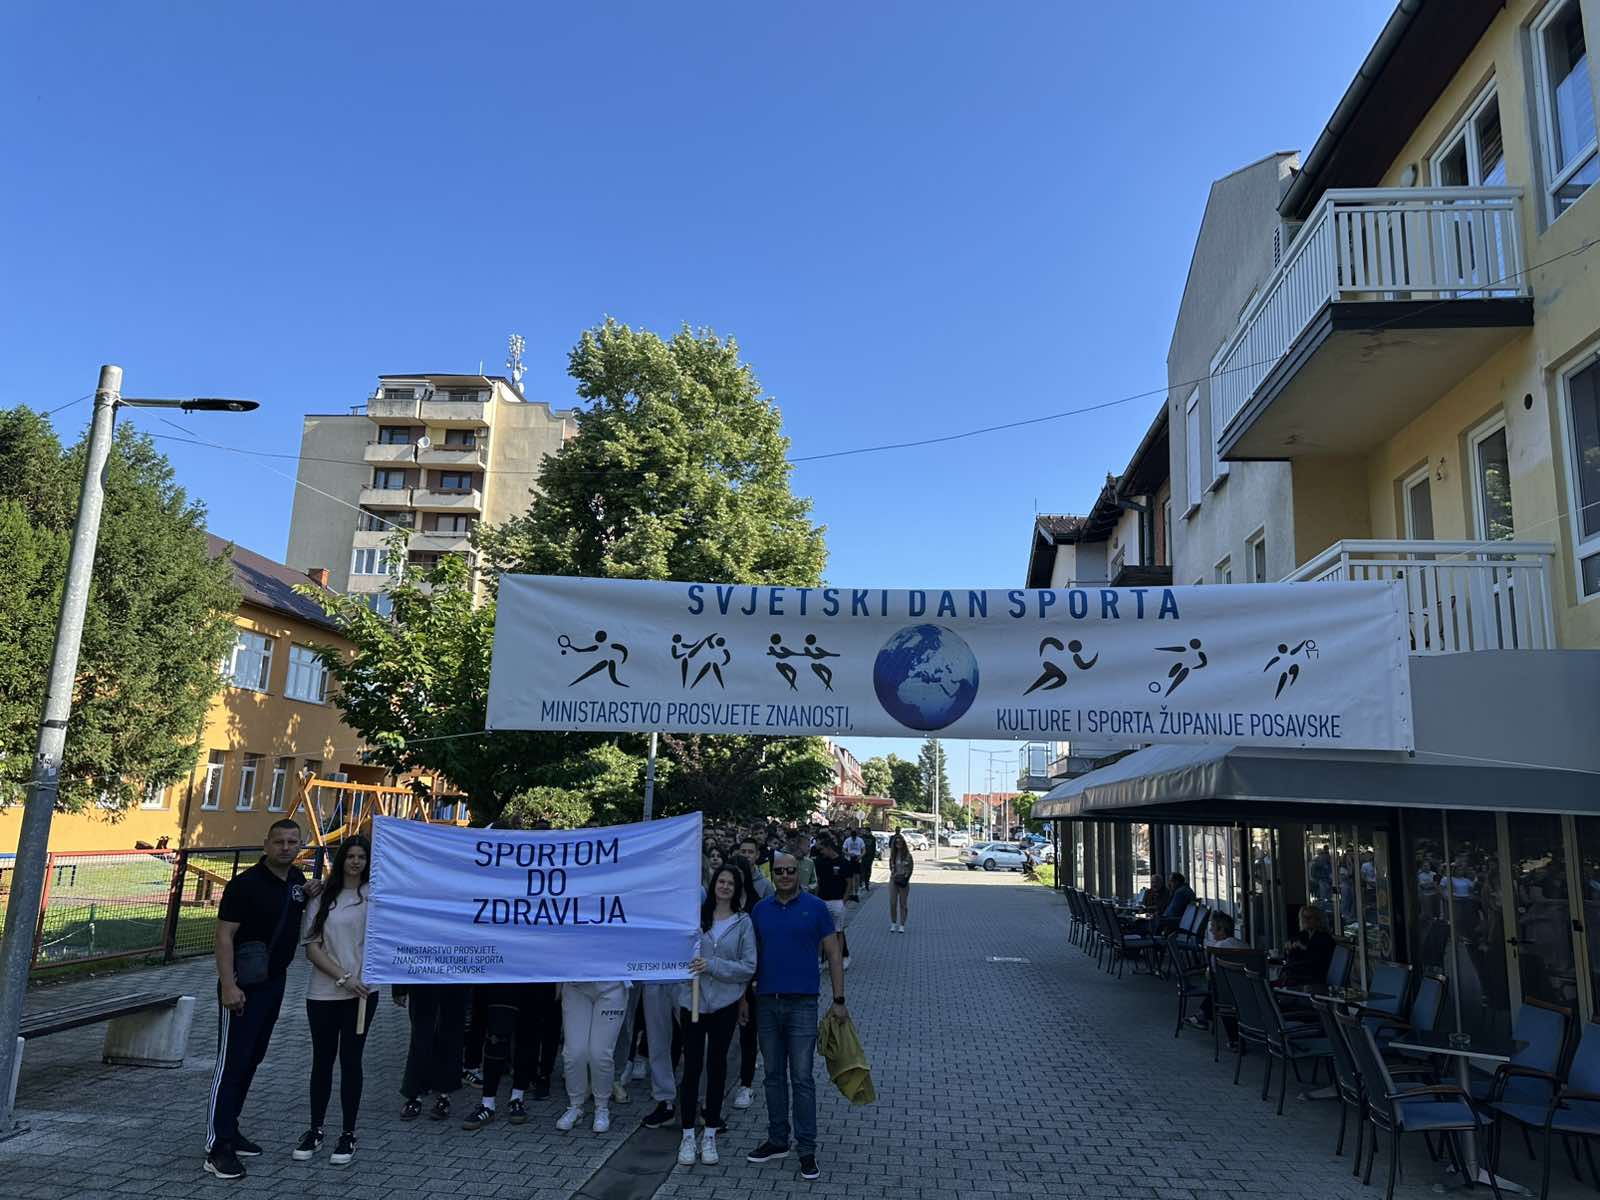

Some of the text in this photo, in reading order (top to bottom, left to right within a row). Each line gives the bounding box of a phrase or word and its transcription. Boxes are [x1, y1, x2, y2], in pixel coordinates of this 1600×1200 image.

[687, 584, 1180, 620] SVJETSKI DAN SPORTA
[541, 700, 854, 731] MINISTARSTVO PROSVJETE ZNANOSTI,
[996, 705, 1341, 738] KULTURE I SPORTA ŽUPANIJE POSAVSKE
[474, 838, 619, 867] SPORTOM
[527, 868, 566, 896] DO
[473, 896, 627, 925] ZDRAVLJA
[435, 956, 468, 964] KULTURE
[474, 956, 504, 964] SPORTA
[627, 963, 660, 971] SVJETSKI
